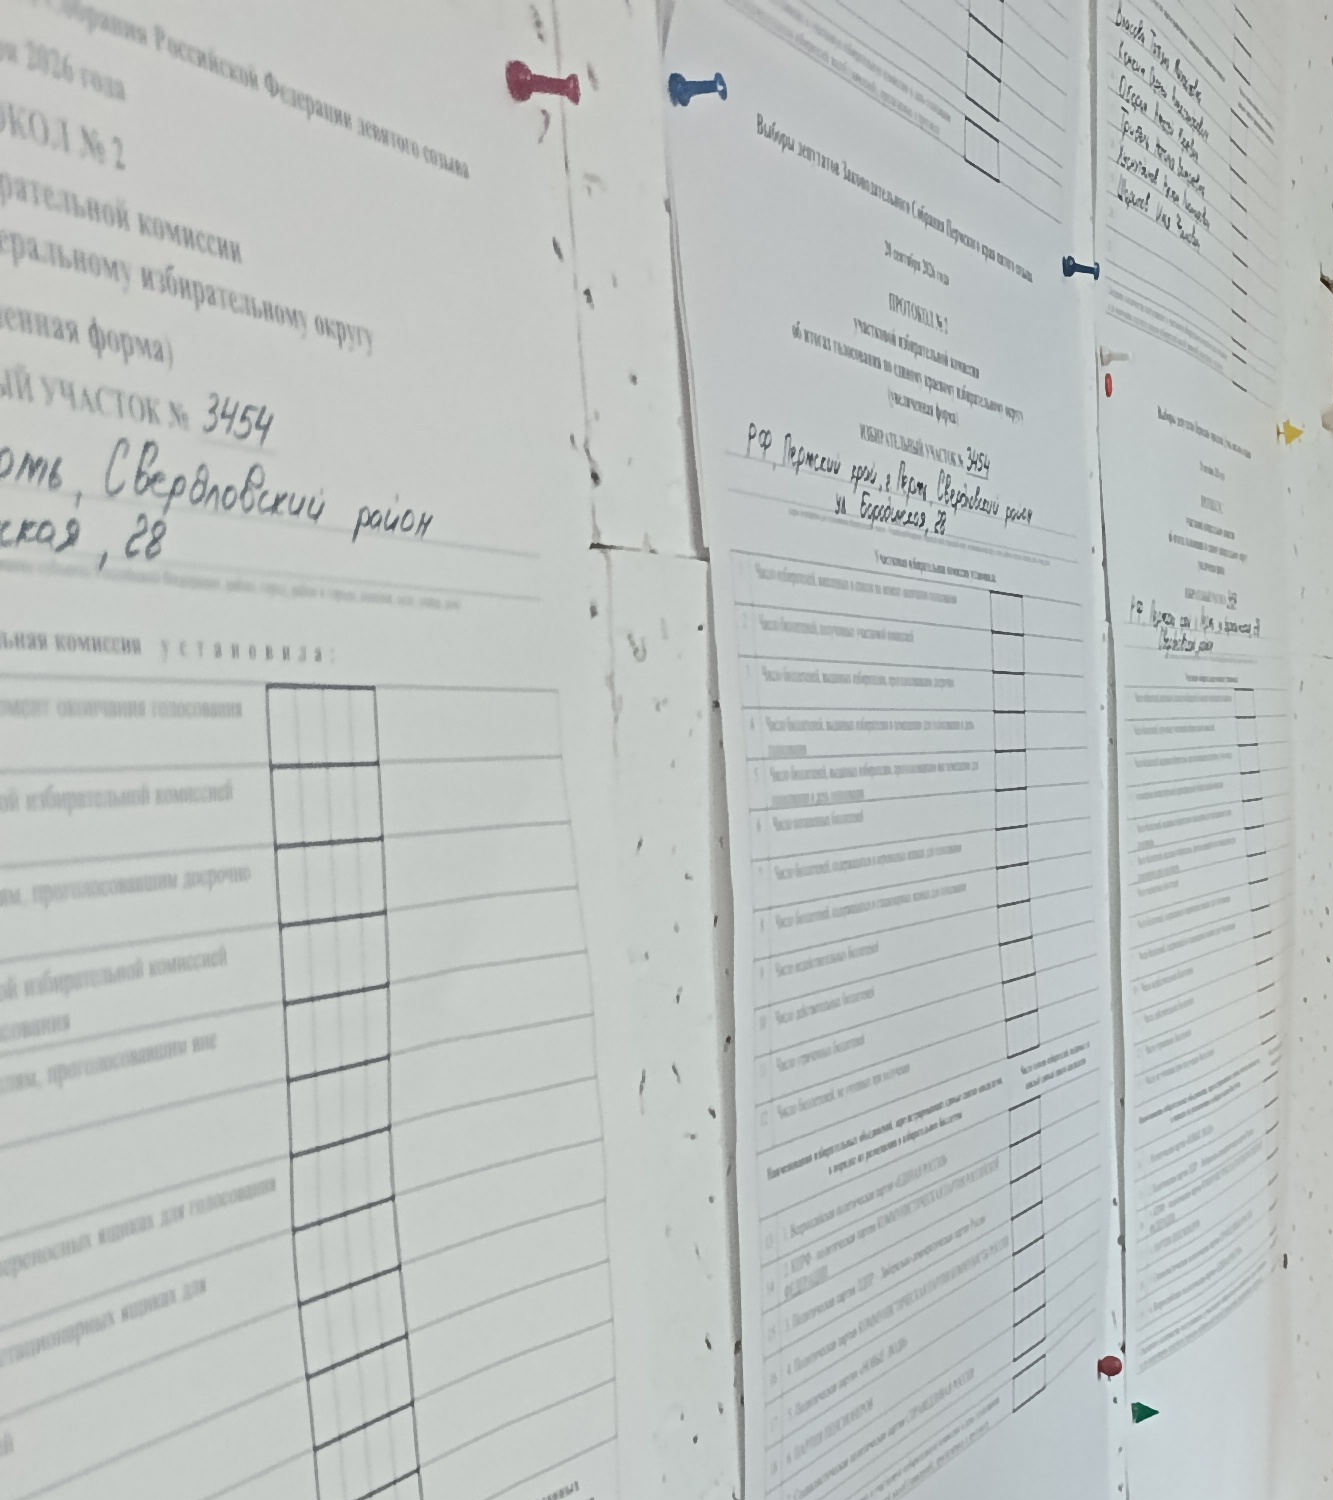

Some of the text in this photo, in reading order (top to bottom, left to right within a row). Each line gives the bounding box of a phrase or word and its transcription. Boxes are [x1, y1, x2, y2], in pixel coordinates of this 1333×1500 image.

[137, 211, 242, 264] комиссии
[141, 264, 308, 338] избирательному
[88, 316, 173, 372] форма)
[41, 375, 160, 427] УЧАСТОК
[202, 391, 274, 447] 3454
[104, 437, 325, 524] Свердловский
[353, 495, 433, 542] район
[125, 513, 167, 560] 28
[55, 633, 141, 655] комиссия
